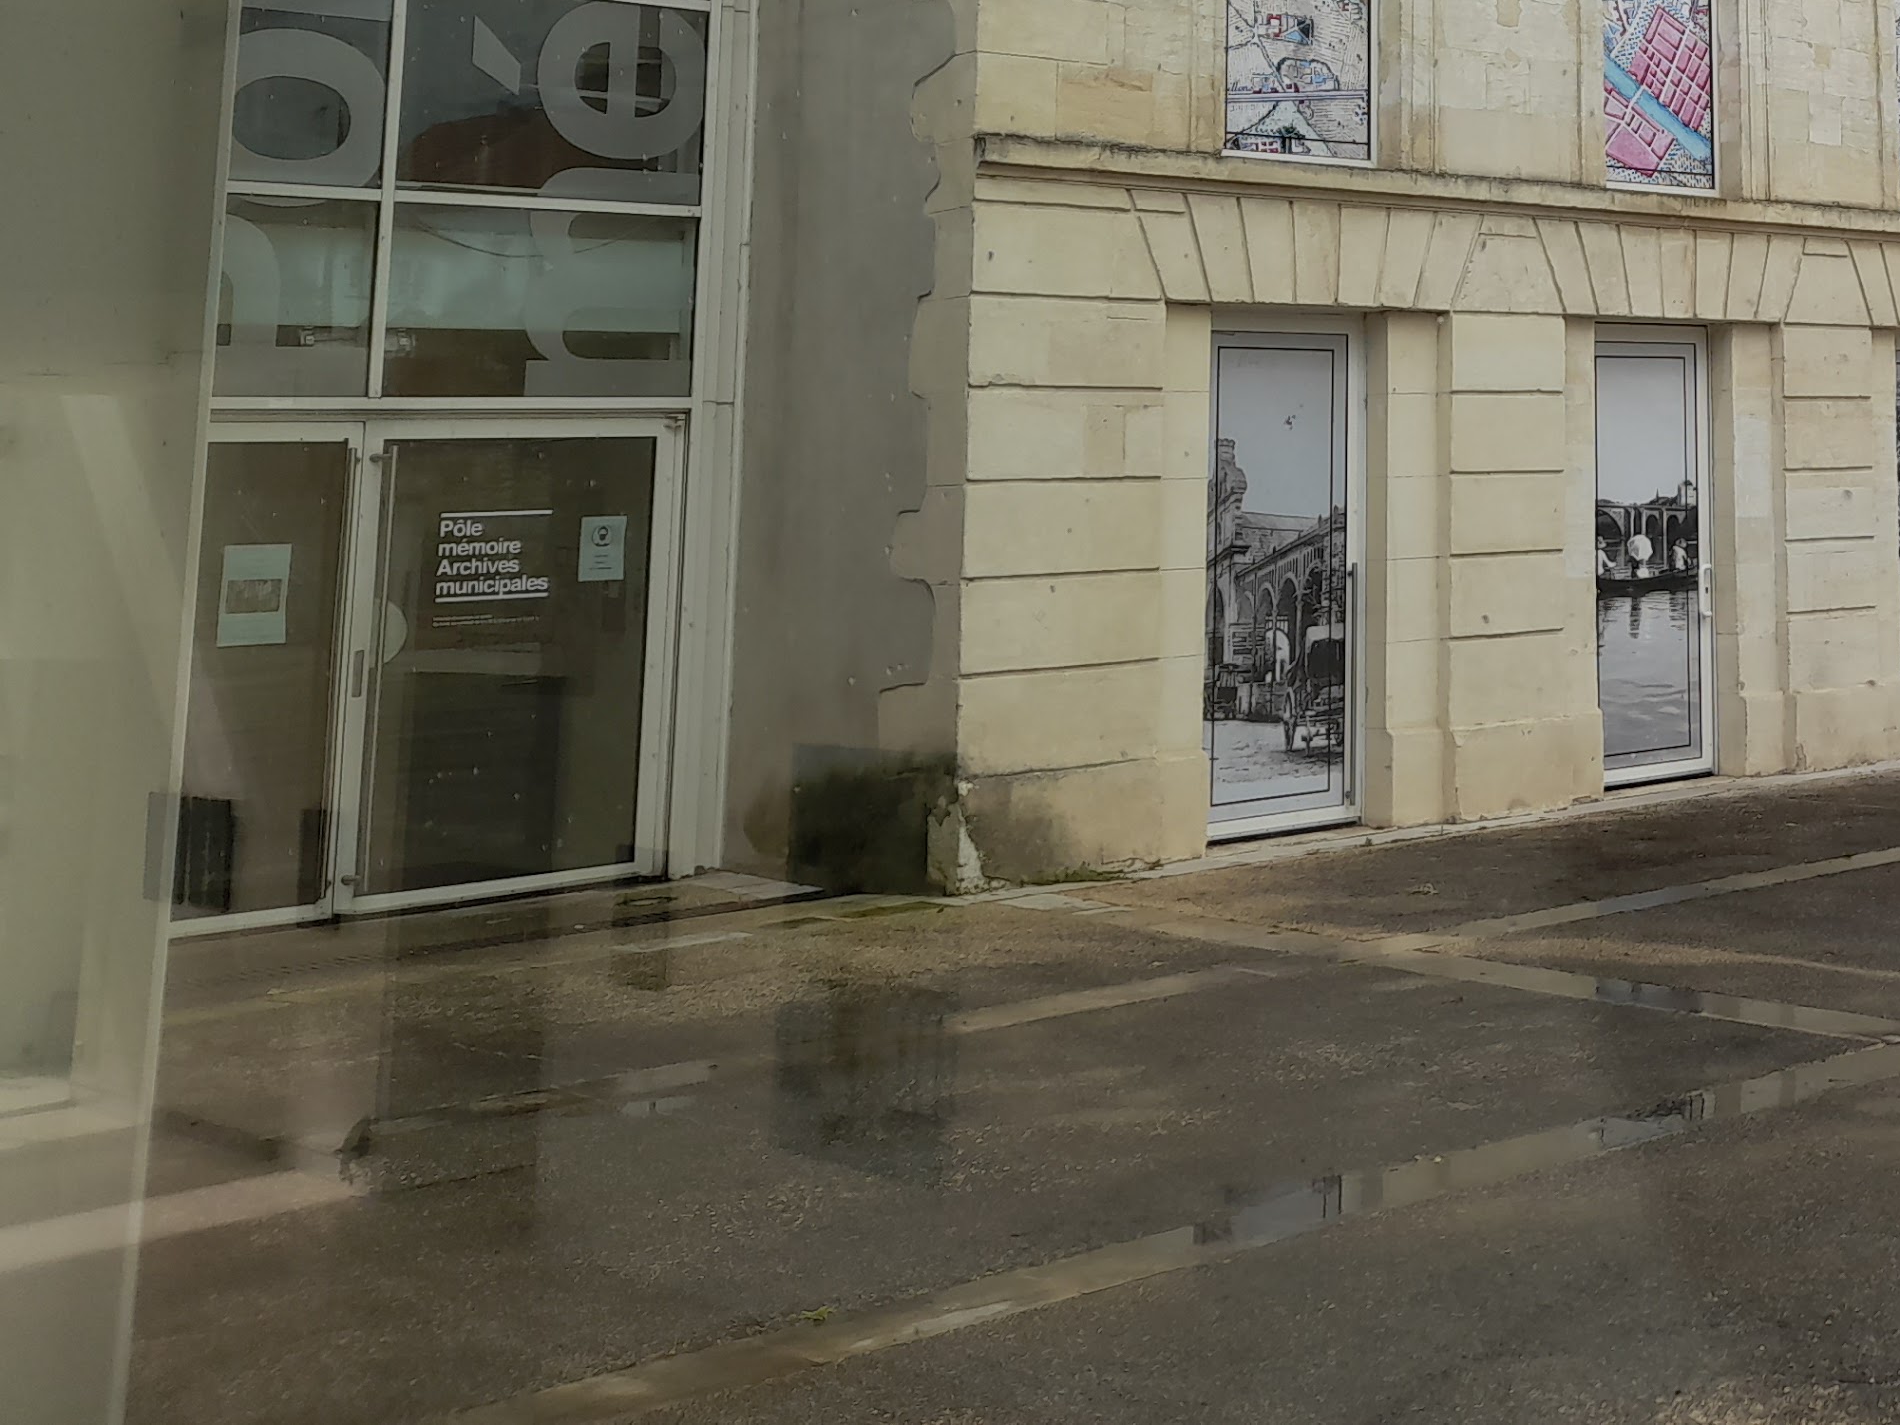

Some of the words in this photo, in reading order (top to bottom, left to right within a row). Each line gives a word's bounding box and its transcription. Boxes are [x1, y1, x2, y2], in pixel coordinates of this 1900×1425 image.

[439, 519, 484, 538] Pôle
[438, 538, 522, 557] mémoire
[436, 557, 520, 576] Archives
[435, 575, 549, 596] municipales
